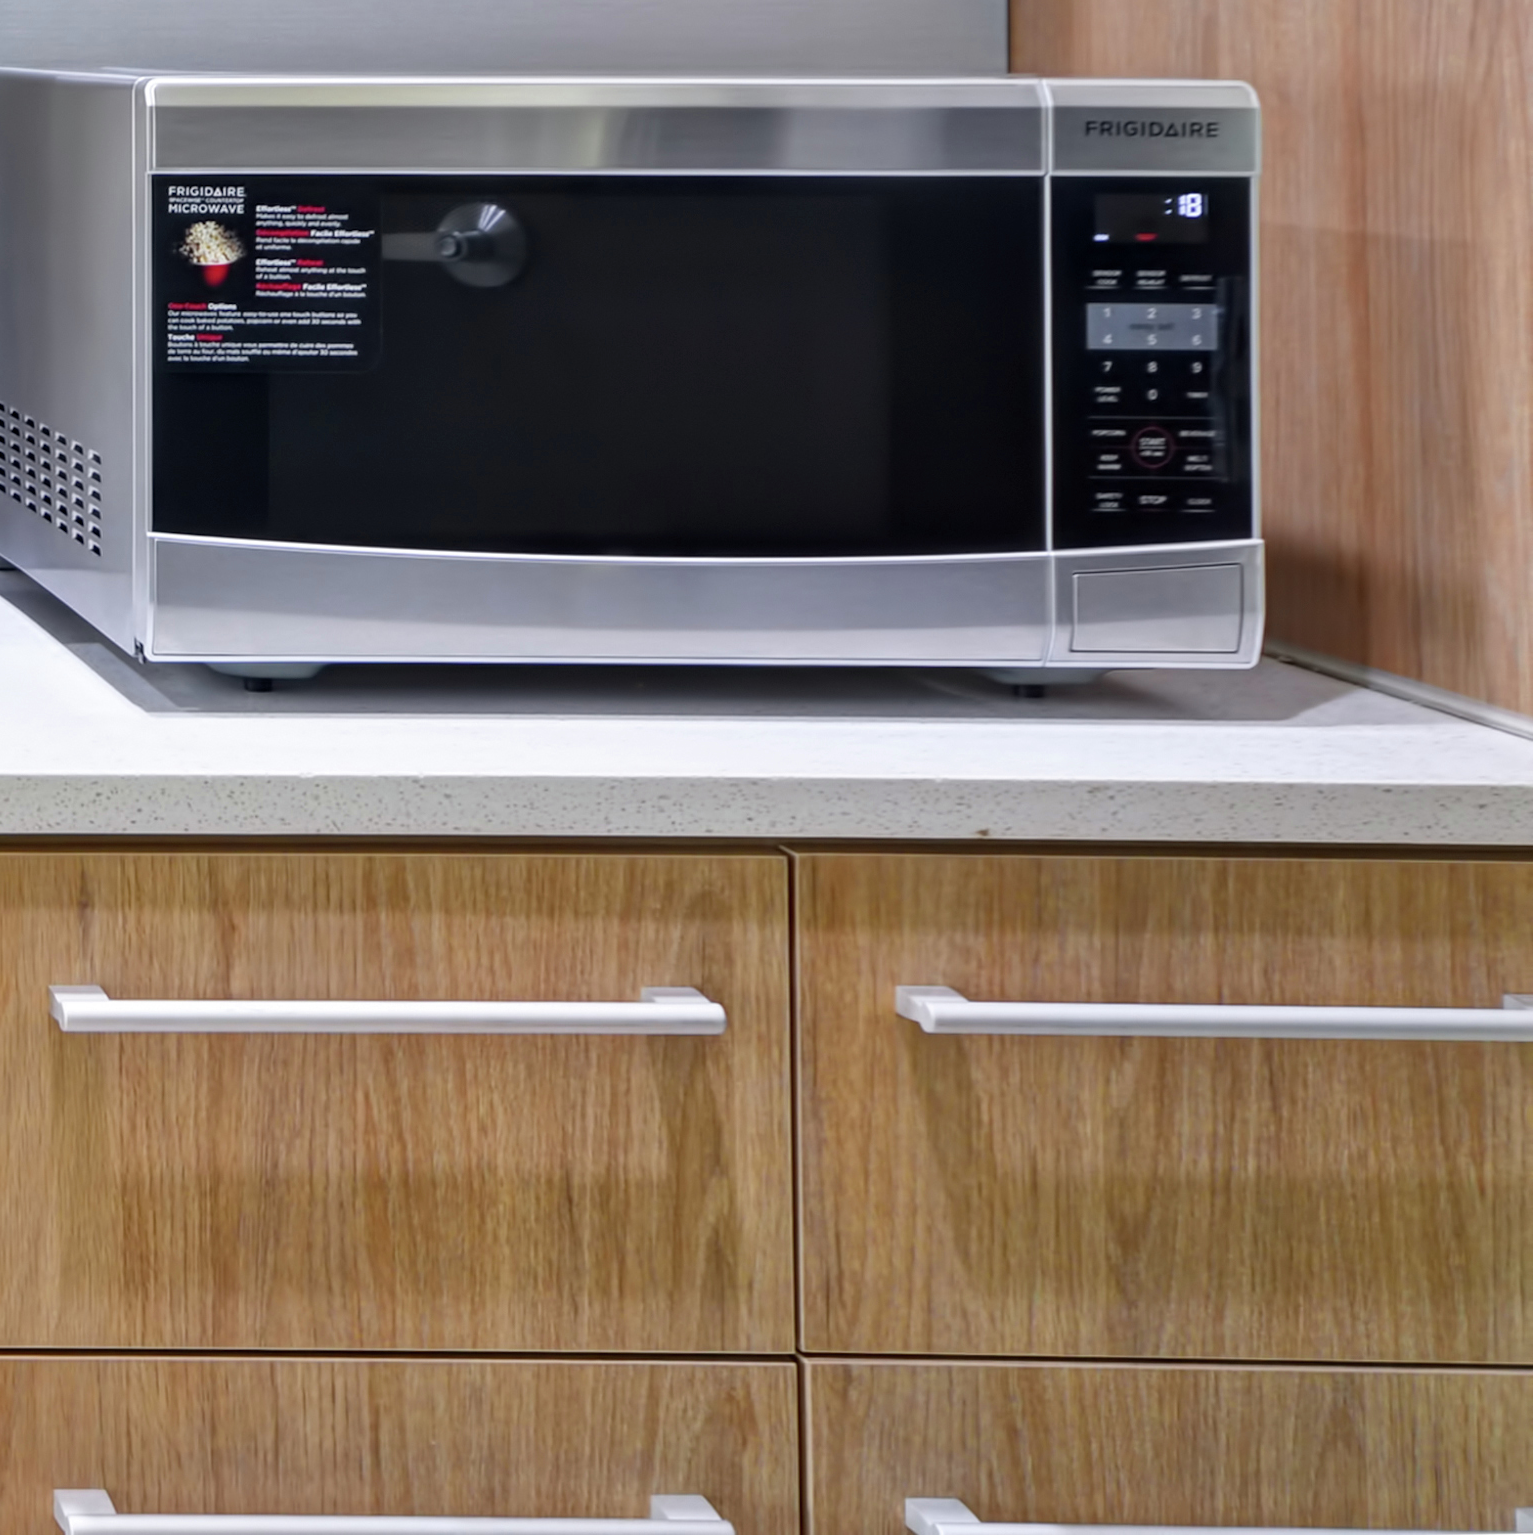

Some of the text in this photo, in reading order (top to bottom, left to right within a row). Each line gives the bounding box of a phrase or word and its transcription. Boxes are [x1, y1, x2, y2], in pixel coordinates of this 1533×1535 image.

[1085, 120, 1220, 137] FRIGIDAIRE
[168, 185, 245, 197] FRIGIDAIRE
[168, 203, 245, 214] MICROWAVE
[1103, 307, 1111, 318] 1
[1146, 307, 1156, 319] 2
[1191, 307, 1202, 320] 3
[1102, 333, 1113, 344] 4
[1147, 333, 1157, 346] 5
[1191, 334, 1202, 346] 6
[1102, 360, 1113, 372] 7
[1146, 360, 1158, 373] 8
[1191, 361, 1203, 374] 9
[1146, 388, 1158, 401] 0
